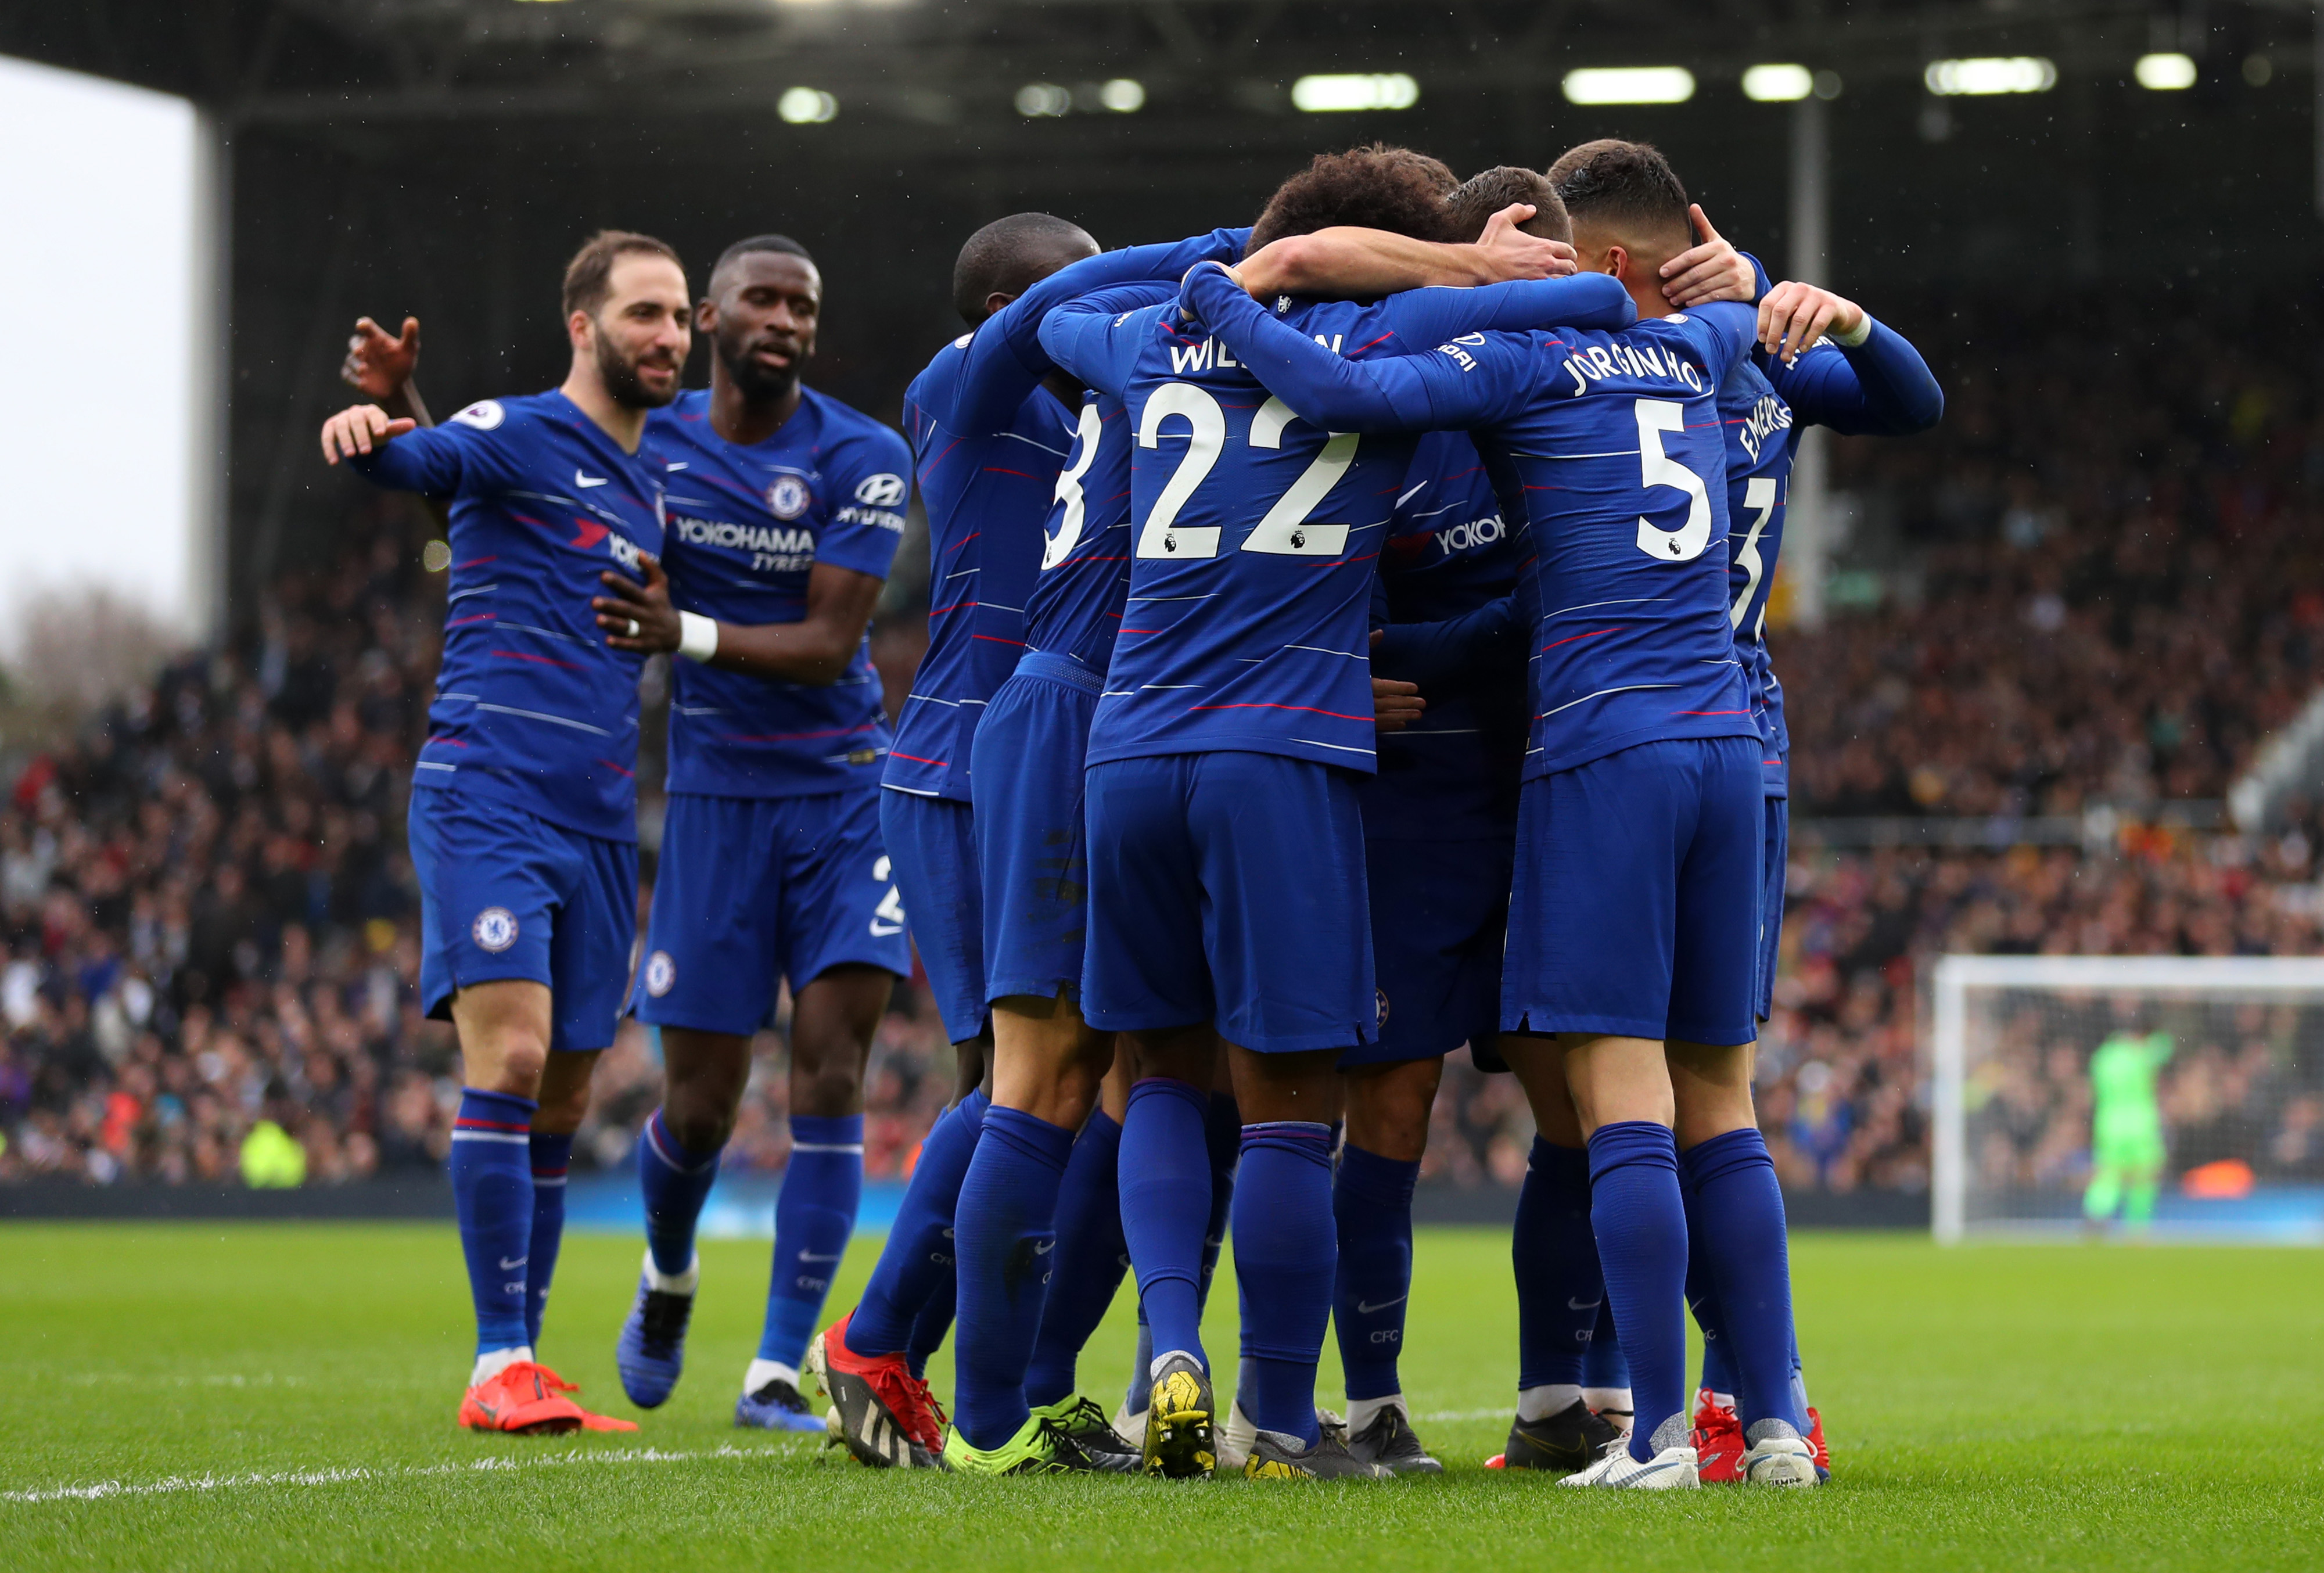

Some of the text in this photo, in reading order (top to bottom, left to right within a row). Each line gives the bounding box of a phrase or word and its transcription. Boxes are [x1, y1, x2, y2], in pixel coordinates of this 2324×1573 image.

[1562, 343, 1702, 397] JORGINHO
[1137, 382, 1360, 559] 22
[1635, 398, 1712, 561] 5
[676, 515, 816, 552] YOKOHAMA
[1370, 1329, 1399, 1343] CFC
